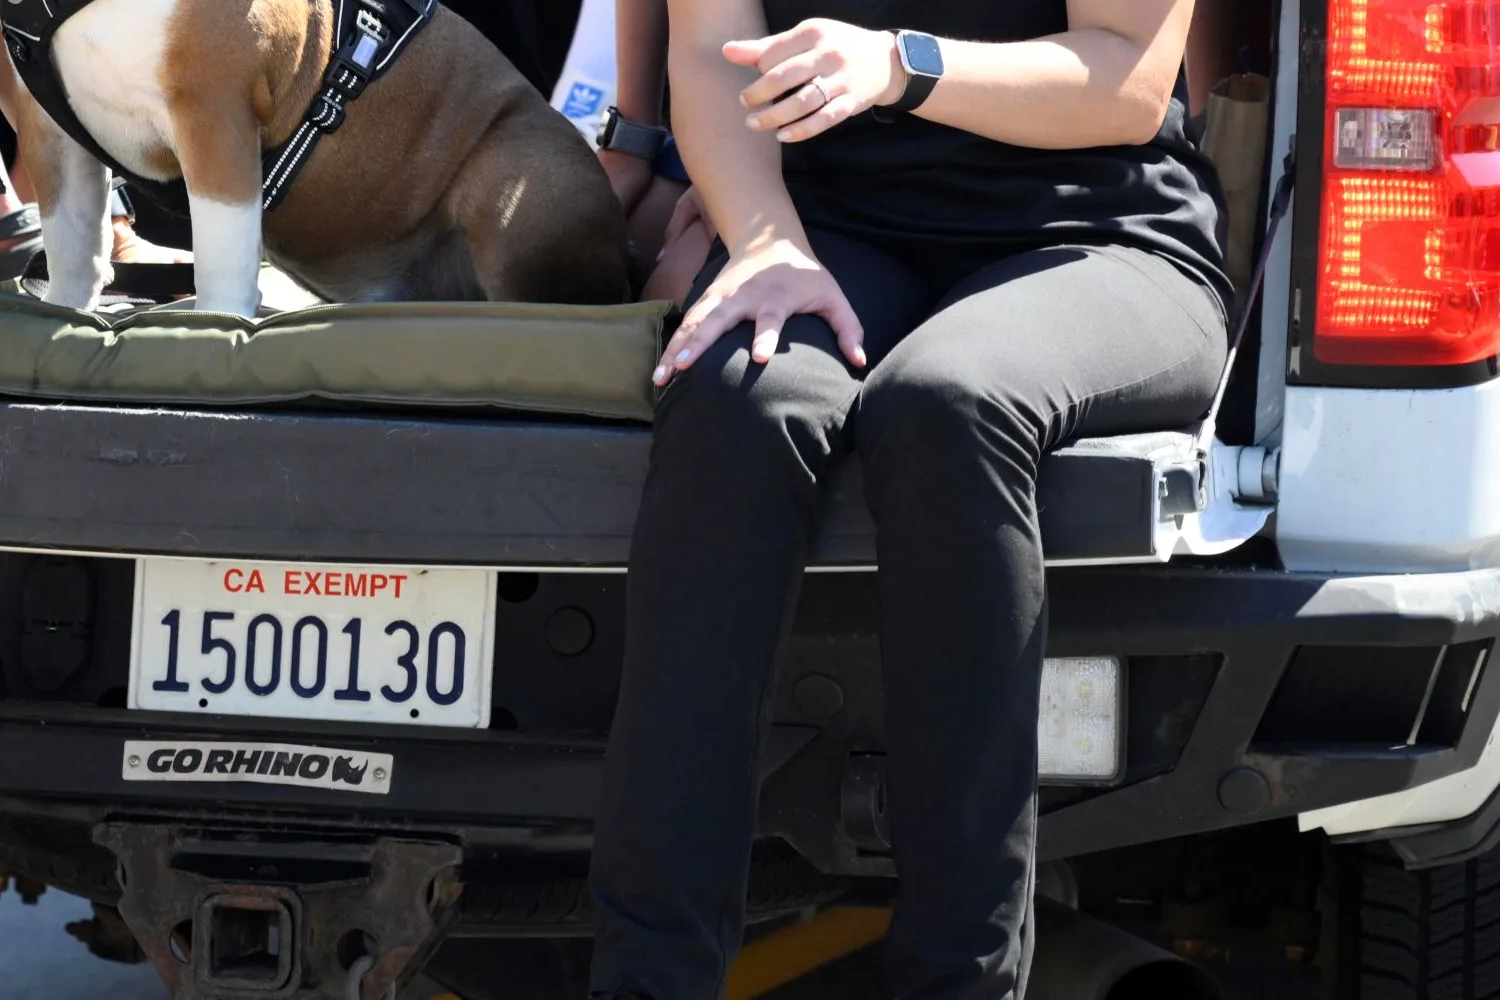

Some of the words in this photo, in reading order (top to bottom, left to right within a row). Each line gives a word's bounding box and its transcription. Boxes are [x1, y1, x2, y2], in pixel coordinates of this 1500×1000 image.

[223, 567, 266, 593] CA
[283, 569, 408, 599] EXEMPT
[152, 608, 467, 706] 1500130
